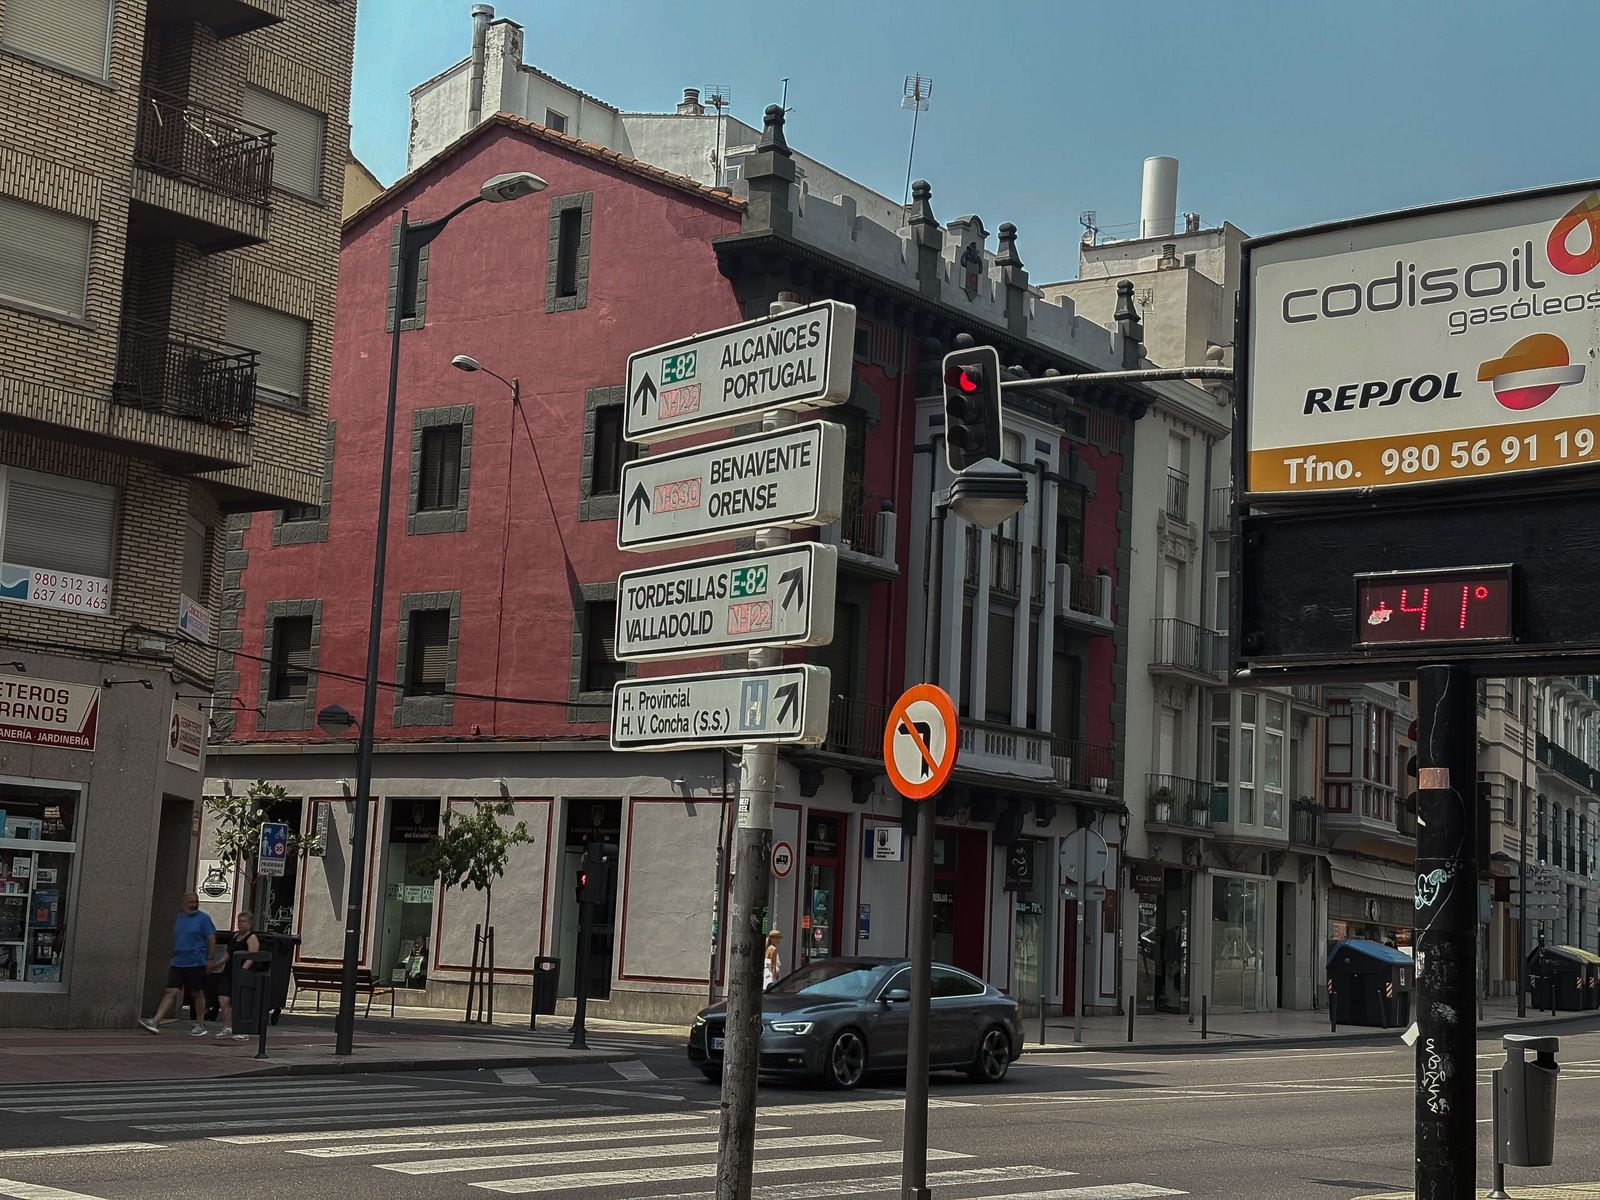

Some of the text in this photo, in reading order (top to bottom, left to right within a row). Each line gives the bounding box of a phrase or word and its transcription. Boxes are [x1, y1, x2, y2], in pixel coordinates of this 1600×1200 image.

[1283, 241, 1545, 323] codisoil
[1449, 291, 1600, 335] gasóleos
[721, 320, 821, 370] ALCAÑICES
[661, 353, 696, 383] E-82
[723, 357, 817, 402] PORTUGAL
[659, 386, 700, 419] N-122
[1303, 372, 1462, 415] REPSOL
[710, 440, 812, 485] BENAVENTE
[1283, 428, 1594, 484] Tfno. 980 56 91 19
[655, 480, 701, 512] N-630
[708, 483, 778, 518] ORENSE
[33, 588, 107, 610] 637 400 465
[34, 572, 109, 594] 980 512 314
[627, 567, 768, 611] TORDESILLAS E-82
[625, 602, 773, 643] VALLADOLID N-122
[622, 692, 634, 711] H.
[639, 687, 690, 711] Provincial
[37, 731, 90, 746] JARDINERÍA
[621, 707, 731, 736] H. V. Concha (S.S.)
